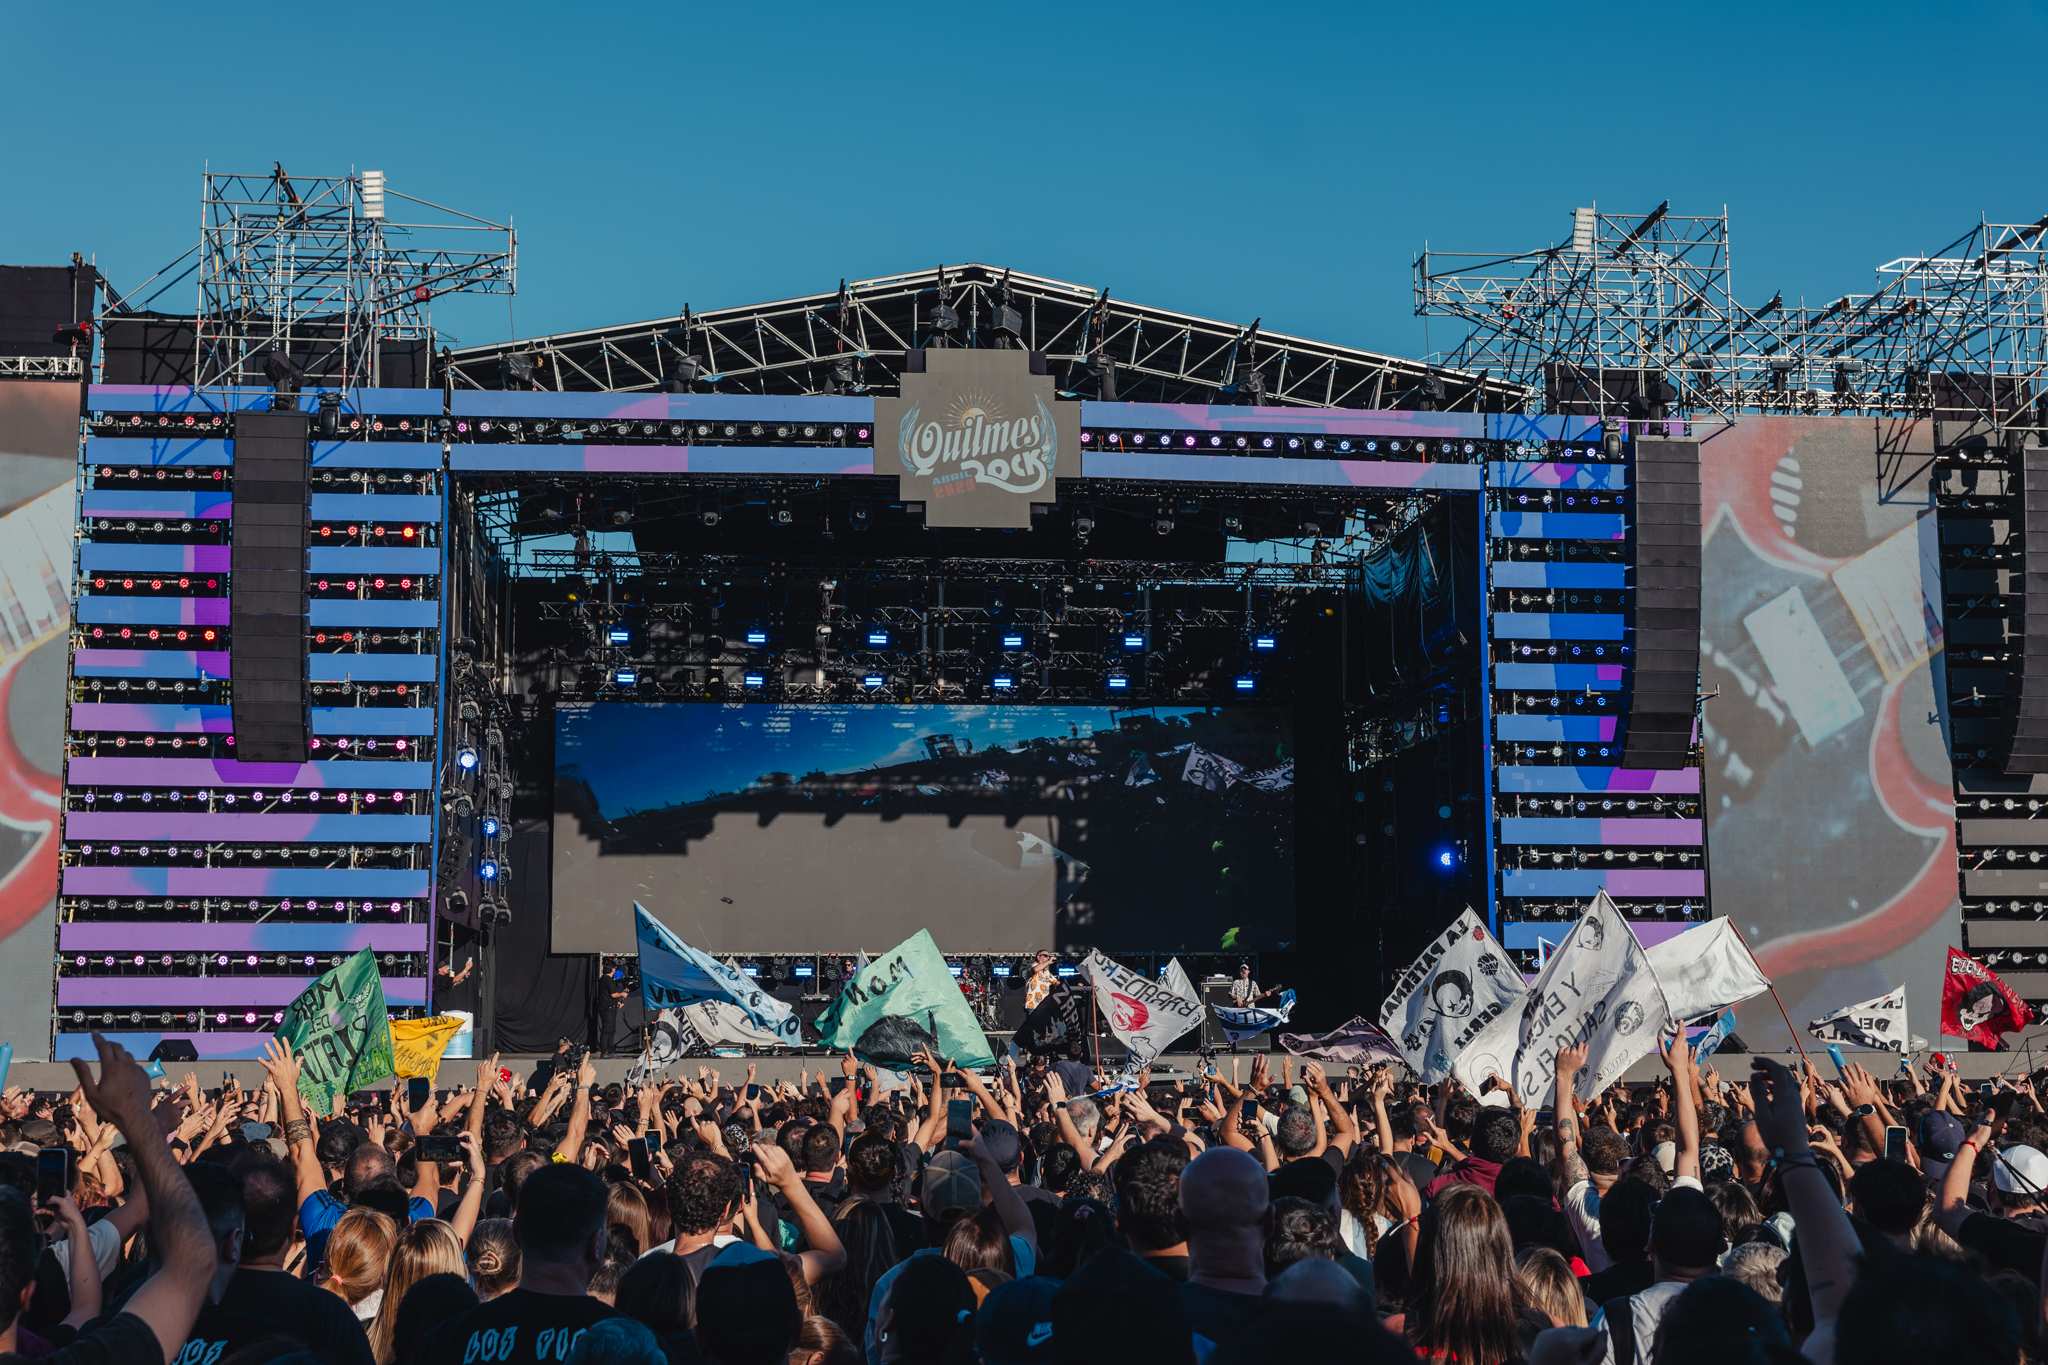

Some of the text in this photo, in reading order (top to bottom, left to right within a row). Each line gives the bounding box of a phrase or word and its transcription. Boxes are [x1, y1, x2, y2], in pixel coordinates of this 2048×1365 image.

[911, 414, 1040, 478] Quilmes
[932, 470, 973, 486] ABRIL
[934, 479, 975, 498] 2025
[463, 1326, 519, 1365] LOS
